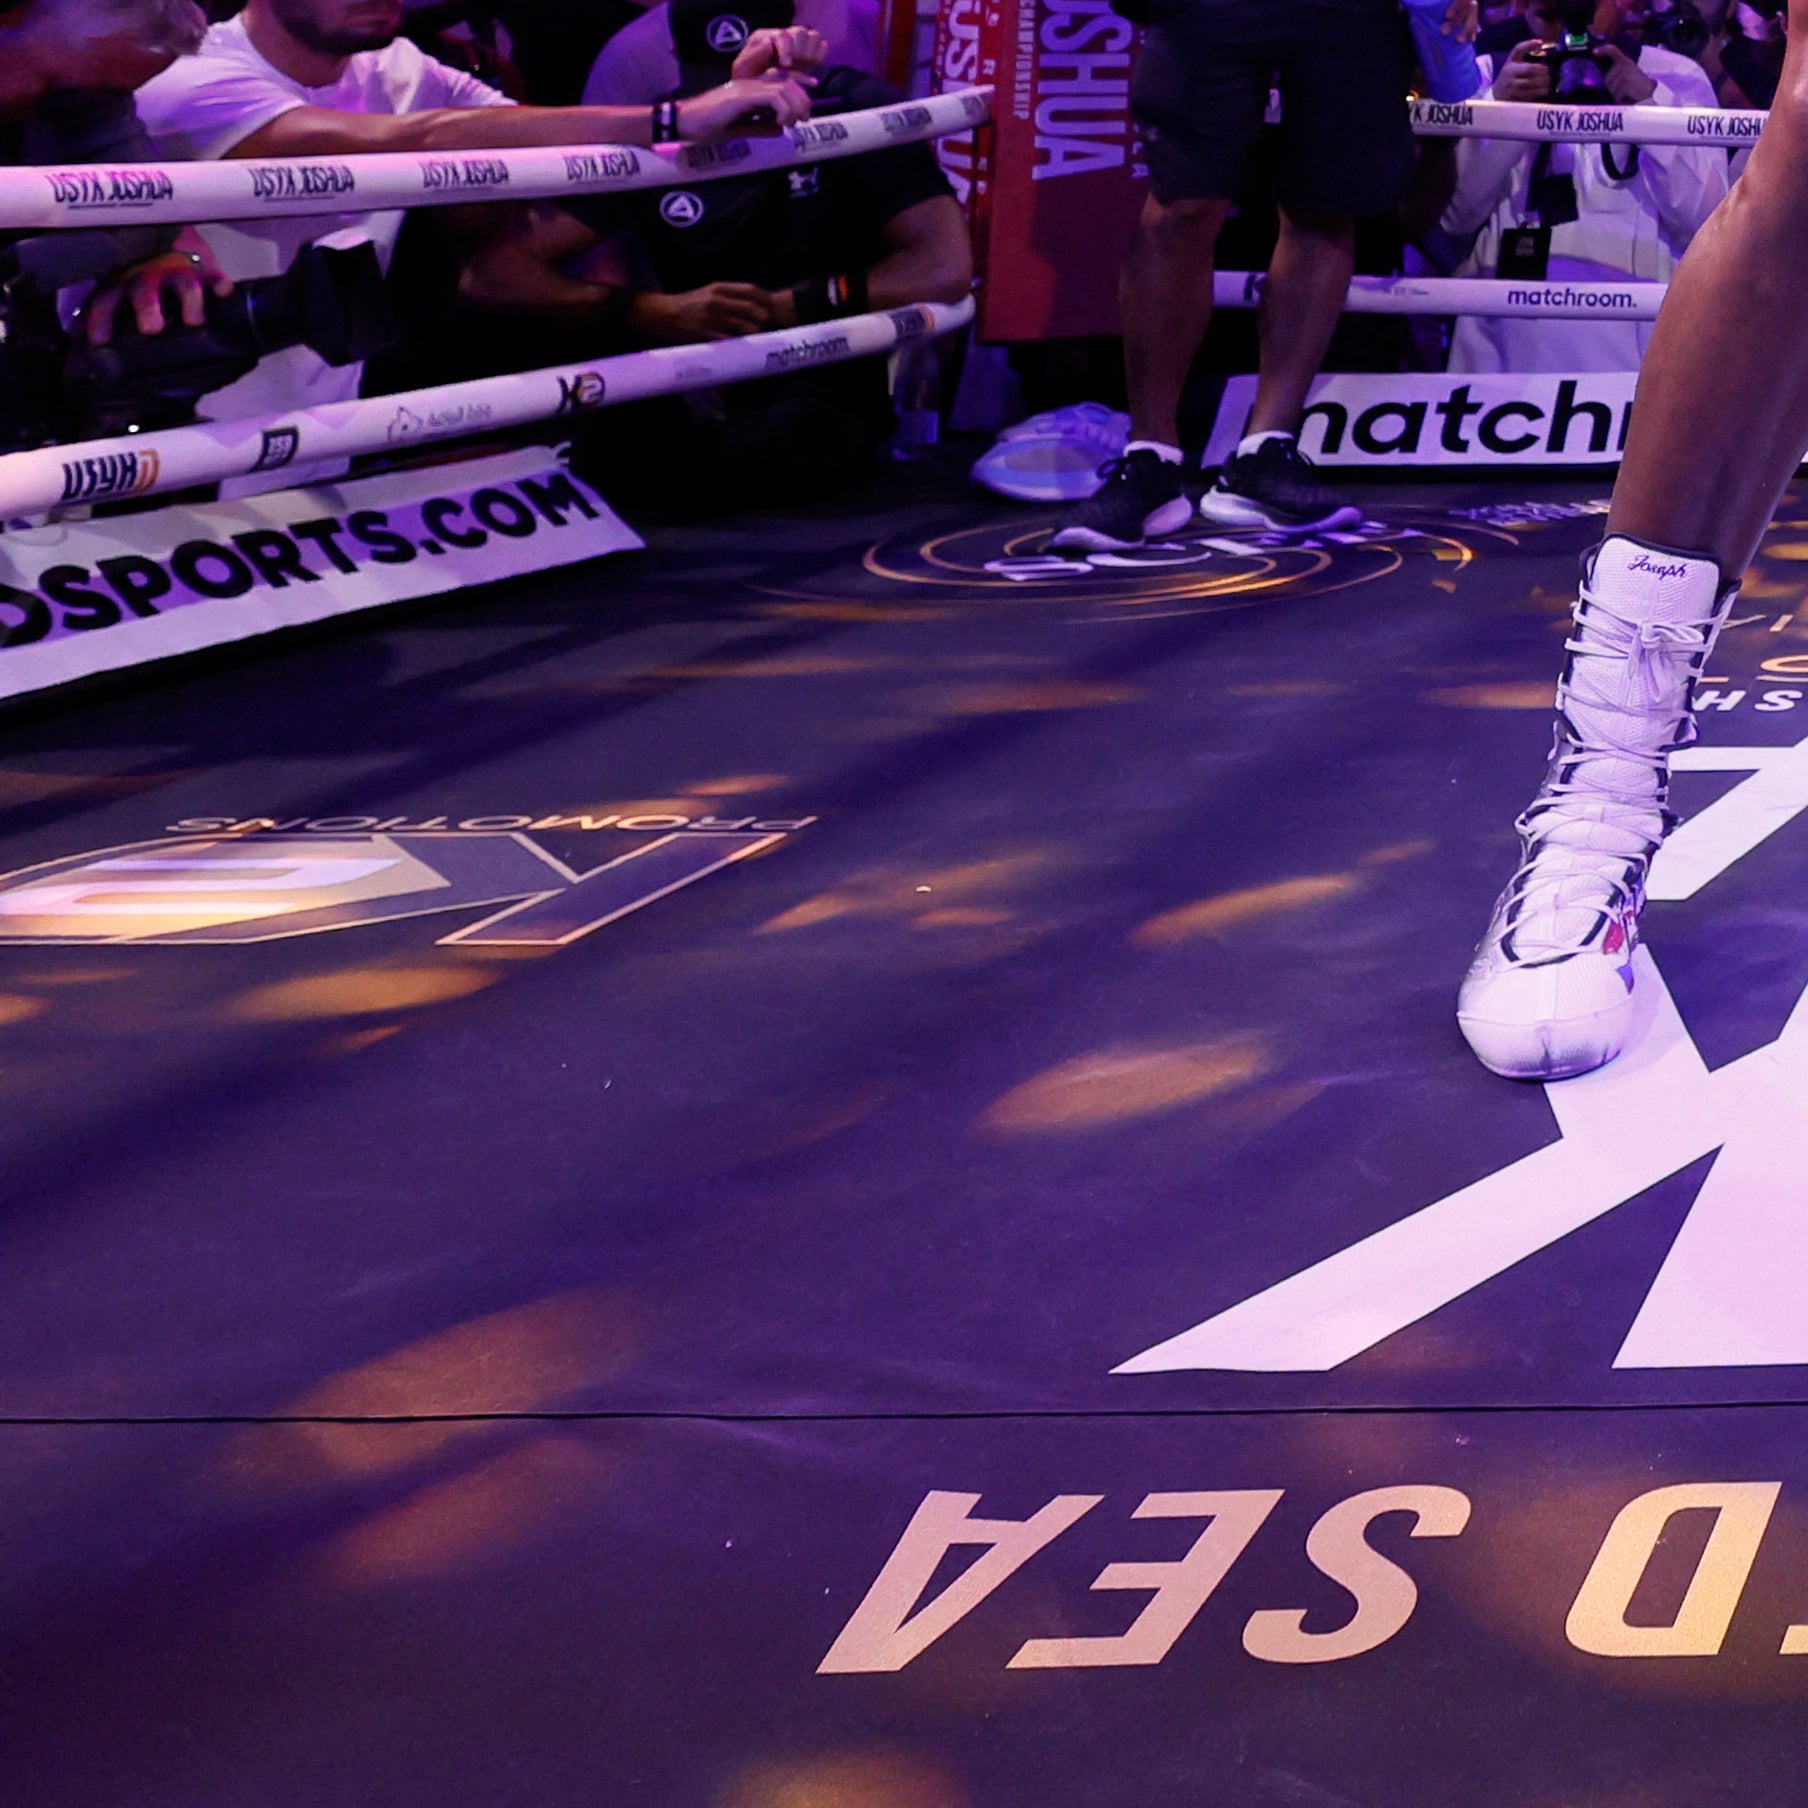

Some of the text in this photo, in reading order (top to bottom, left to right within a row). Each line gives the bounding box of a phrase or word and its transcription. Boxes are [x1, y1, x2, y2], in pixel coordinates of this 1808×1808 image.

[1427, 105, 1474, 126] JOSHUA
[1536, 110, 1624, 132] USYK JOSHUA
[1687, 115, 1768, 137] USYK JOSHU
[1508, 288, 1638, 310] matchroom.
[62, 451, 138, 500] USYK
[166, 814, 819, 833] PROMOTIONS
[815, 1484, 1475, 1676] SEA
